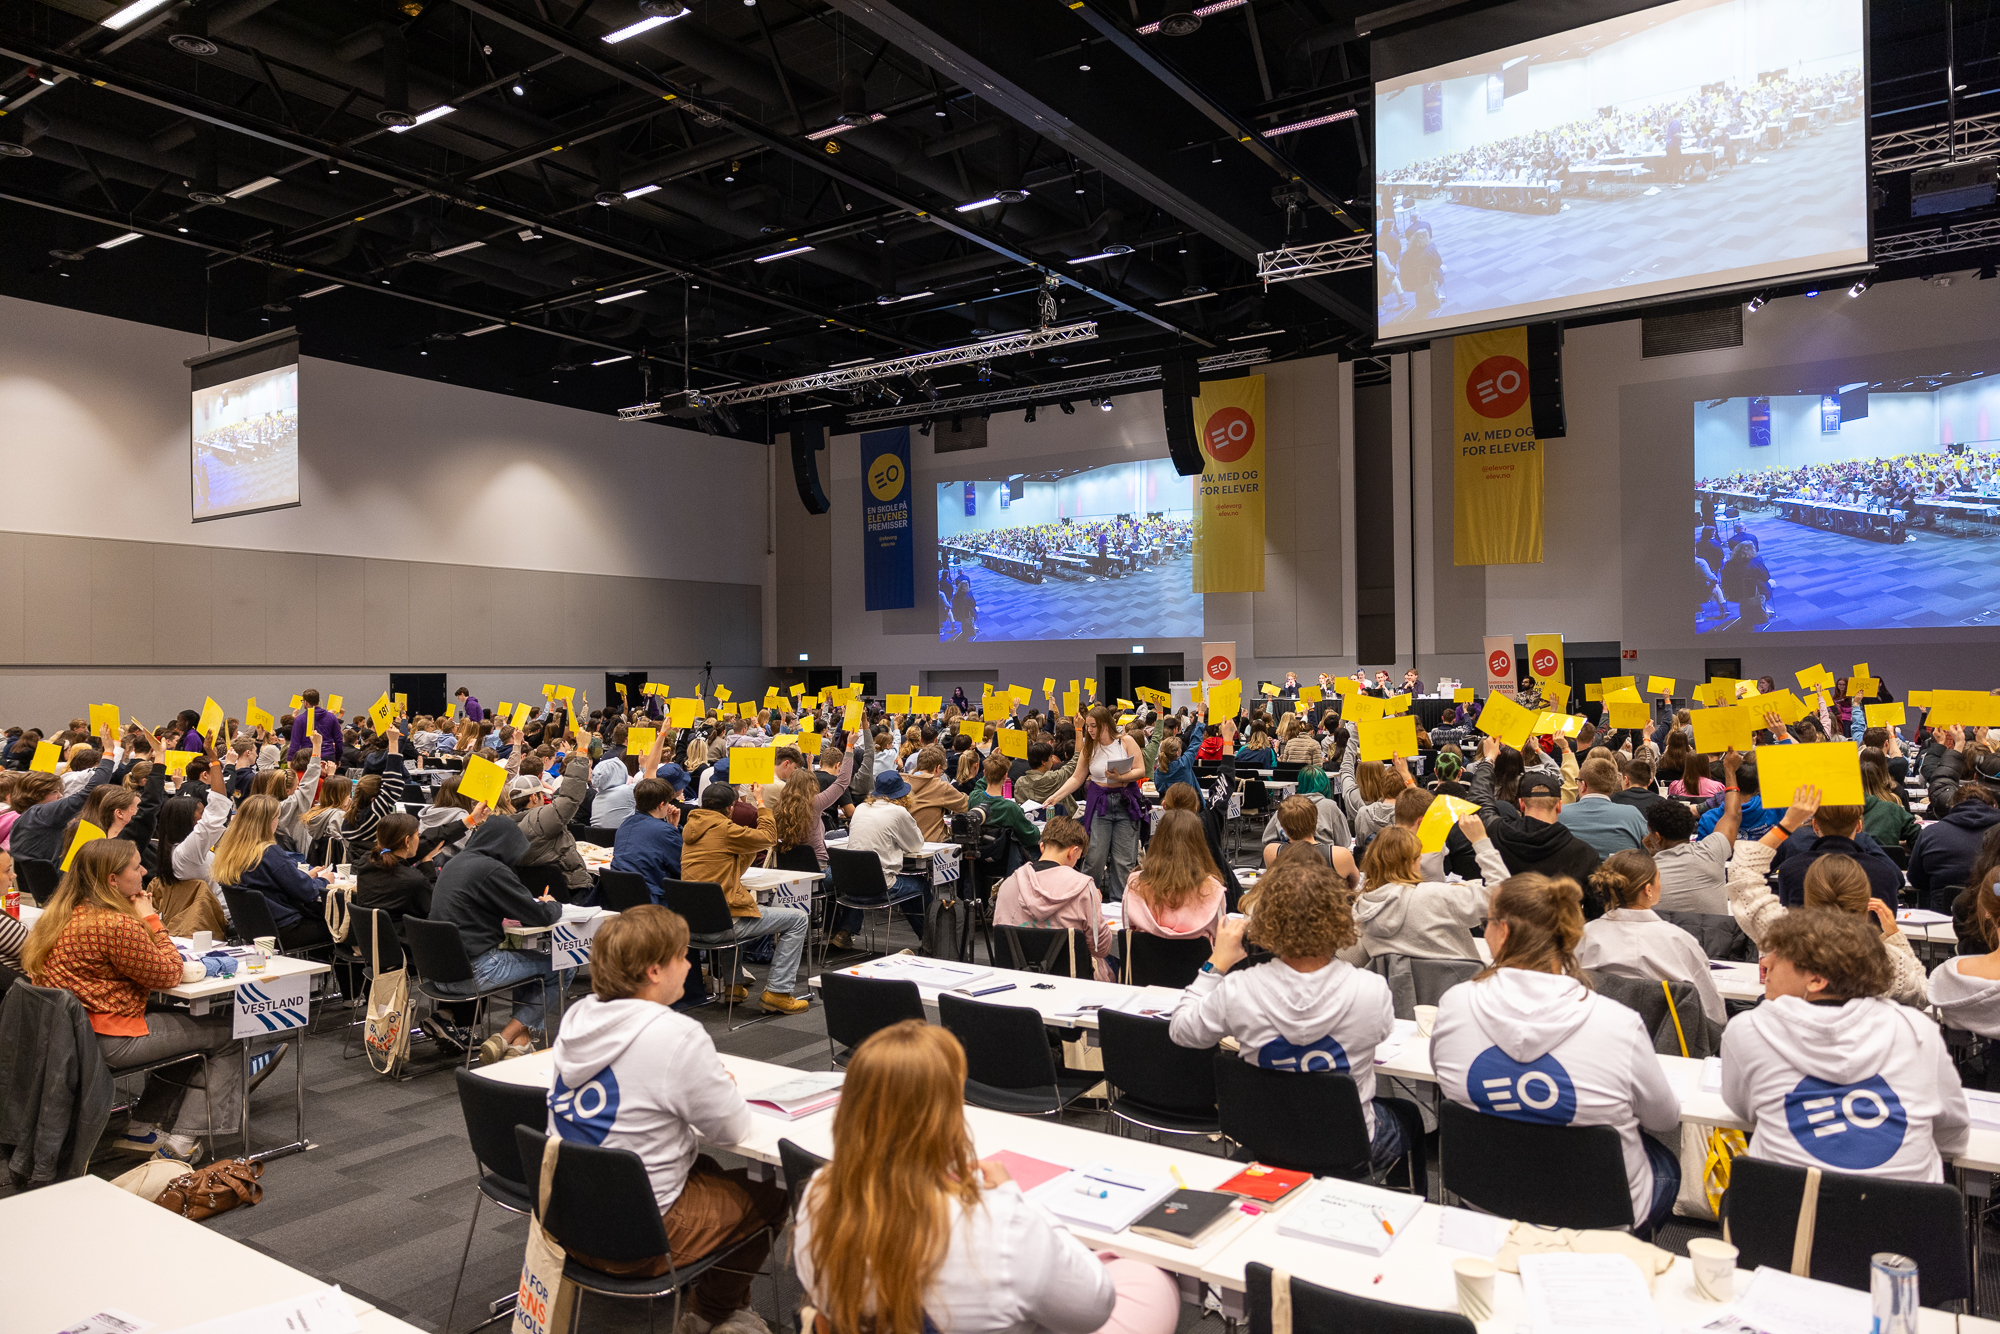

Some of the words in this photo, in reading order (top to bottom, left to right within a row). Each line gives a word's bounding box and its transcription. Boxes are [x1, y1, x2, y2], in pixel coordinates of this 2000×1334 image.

[1464, 432, 1480, 442] AV,
[1484, 429, 1512, 440] MED
[1515, 427, 1534, 437] OG
[1463, 446, 1486, 456] FOR
[1490, 441, 1535, 454] ELEVER
[1482, 464, 1514, 472] @elevorg
[1201, 474, 1215, 483] AV,
[1218, 472, 1239, 482] MED
[1242, 471, 1258, 480] OG
[1200, 486, 1219, 495] FOR
[1222, 484, 1259, 494] ELEVER
[878, 503, 898, 513] SKOLE
[899, 500, 907, 510] PÅ
[868, 510, 907, 523] ELEVENES
[868, 520, 908, 531] PREMISSER
[378, 704, 389, 719] 181
[935, 861, 957, 871] VESTLAND
[777, 894, 808, 904] VESTLAND
[557, 938, 593, 951] VESTLAN
[242, 996, 304, 1014] VESTLAND
